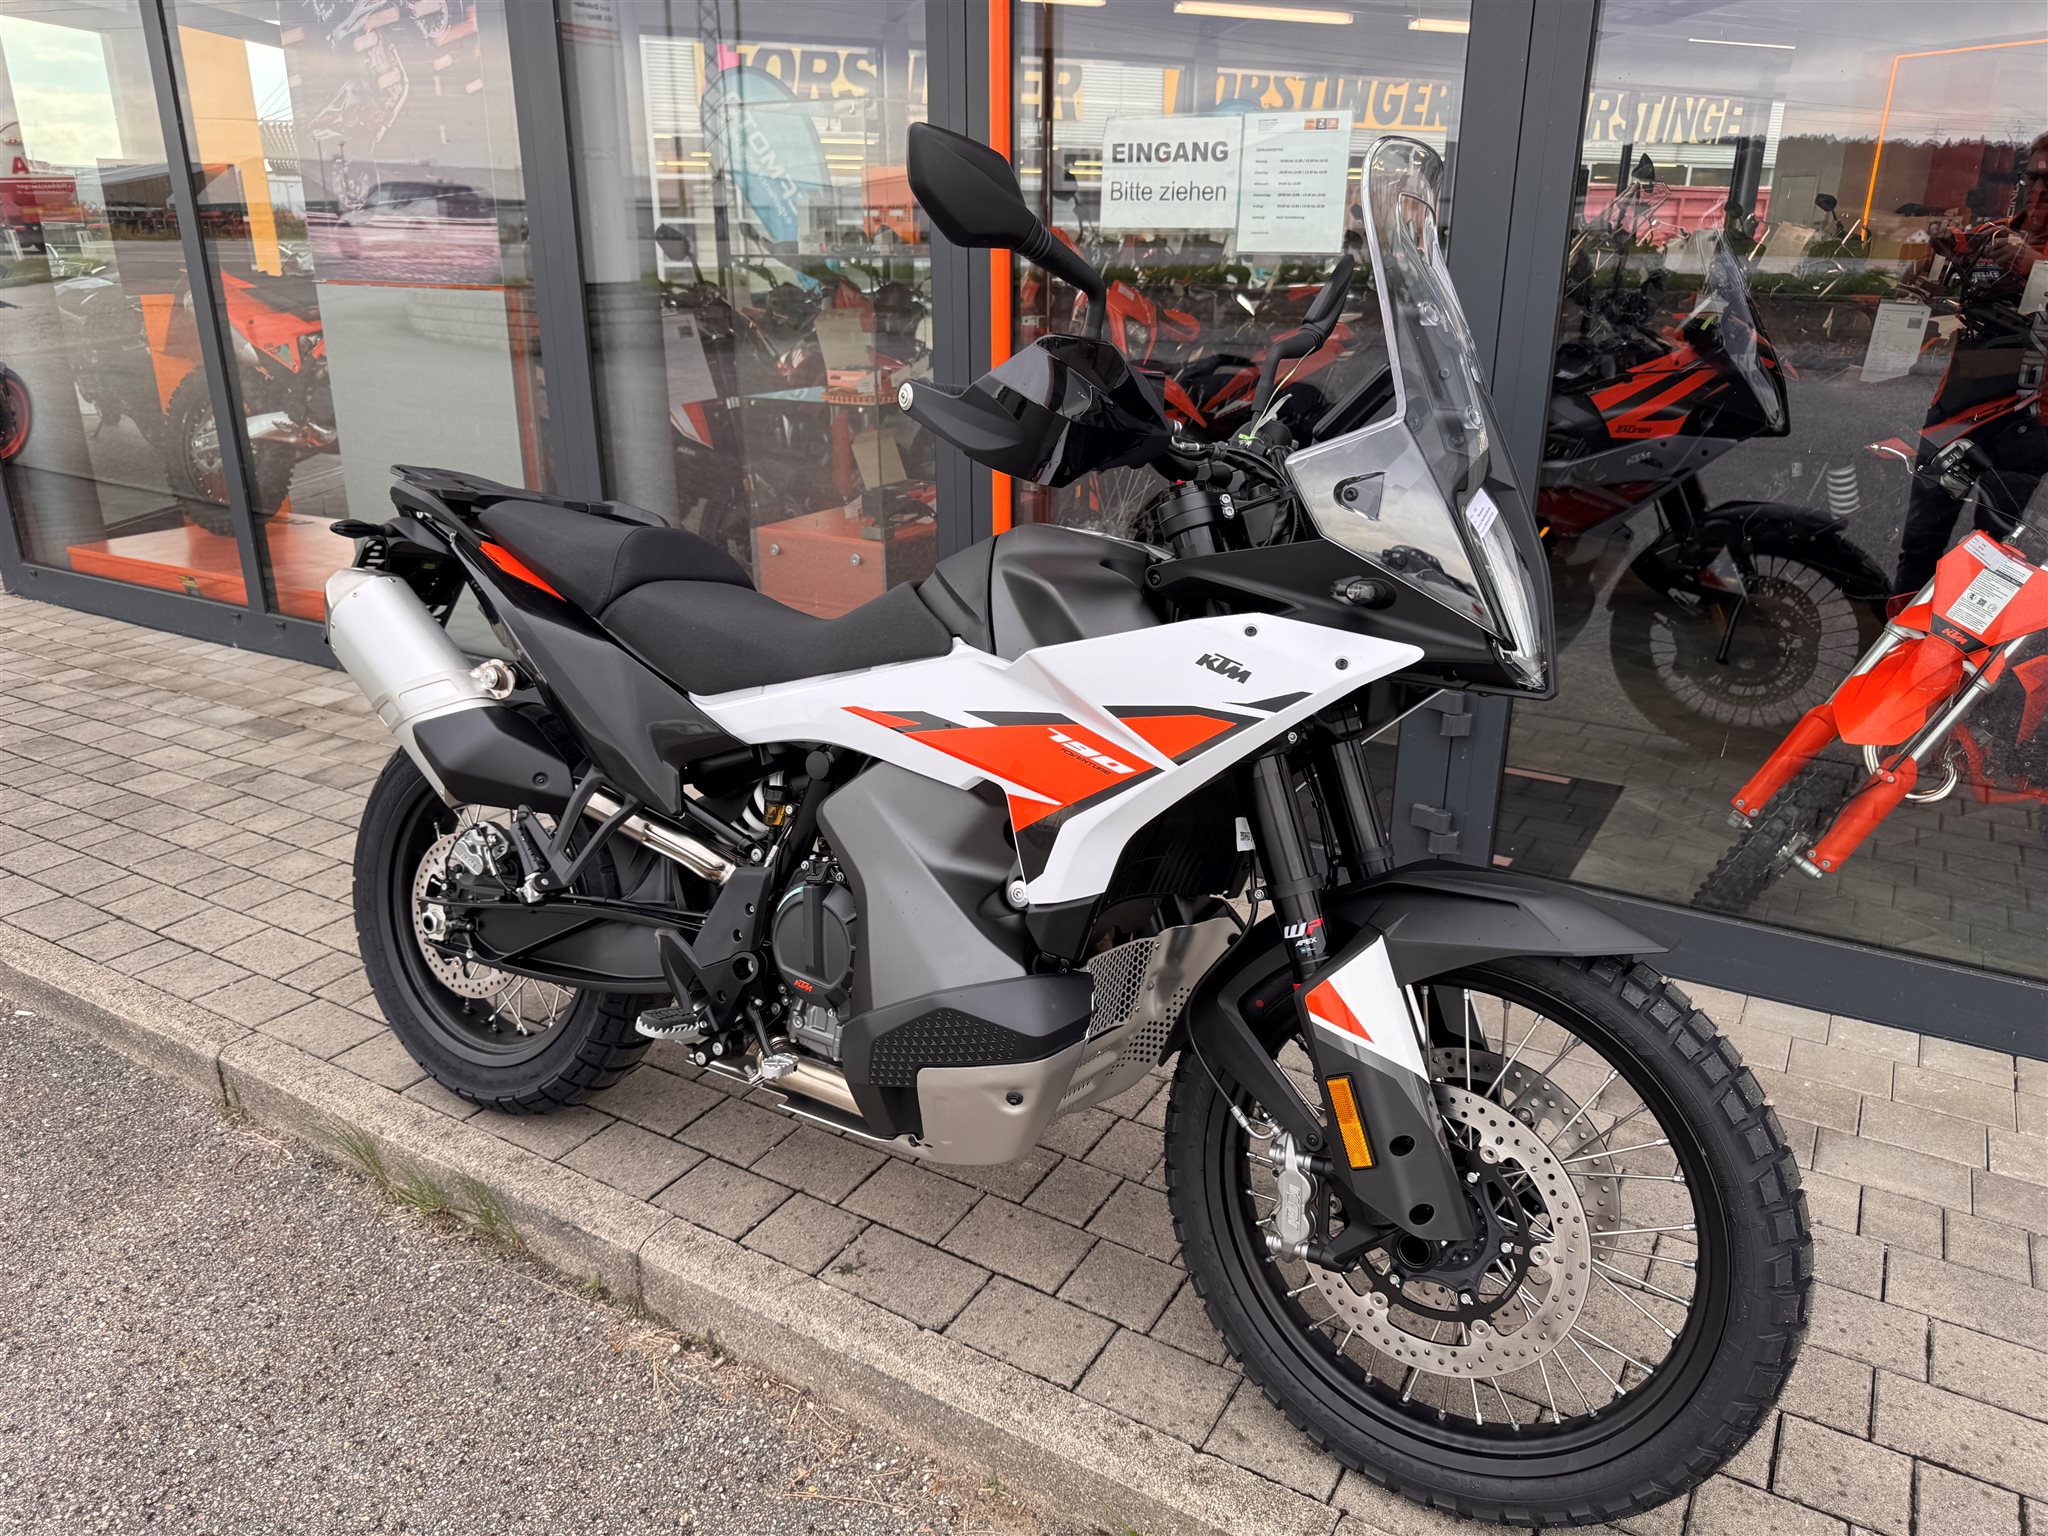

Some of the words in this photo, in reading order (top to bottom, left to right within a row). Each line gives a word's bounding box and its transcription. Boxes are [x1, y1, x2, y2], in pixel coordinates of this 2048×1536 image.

[1112, 141, 1229, 163] EINGANG
[1110, 181, 1153, 201] Bitte
[1159, 181, 1227, 201] ziehen
[1942, 628, 1968, 645] KTM
[1195, 653, 1252, 684] KTM
[1047, 727, 1137, 775] 790
[1284, 917, 1323, 939] WP
[1295, 936, 1318, 947] APEX
[793, 979, 813, 992] KTM
